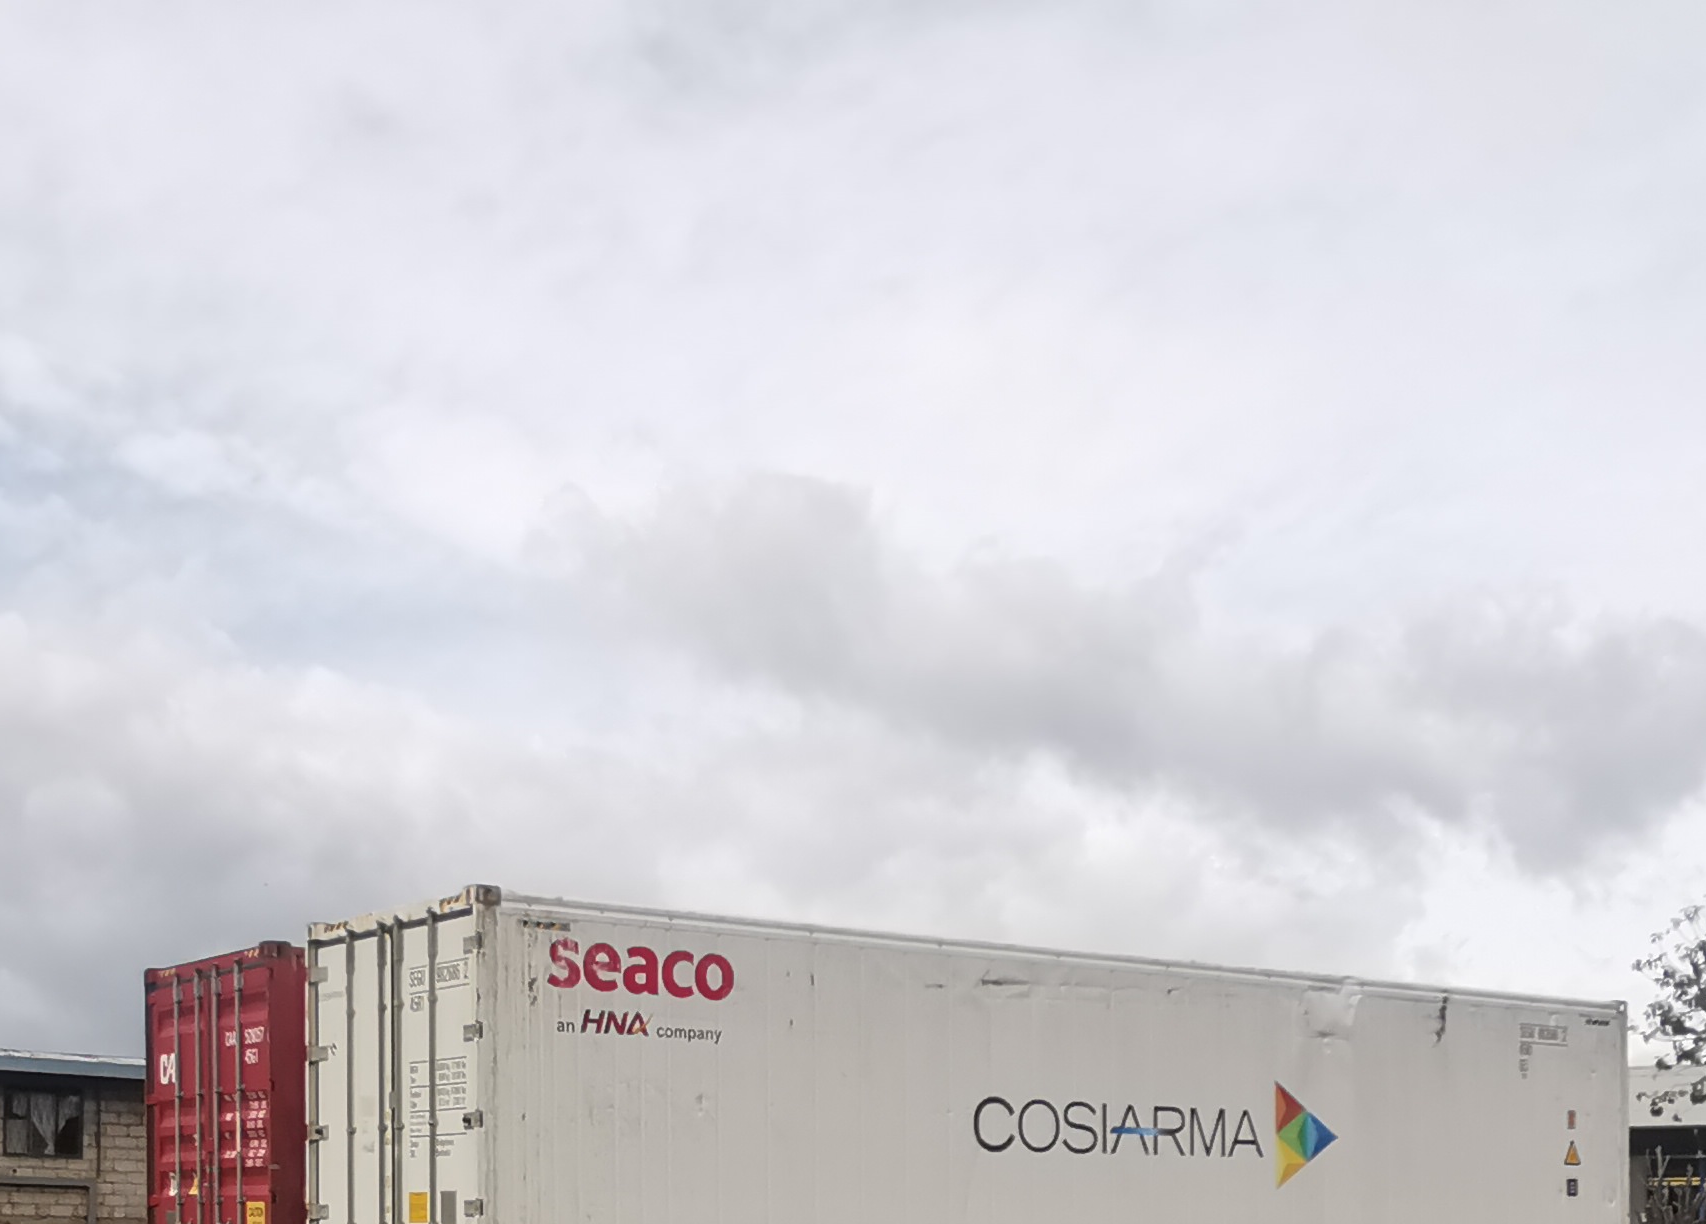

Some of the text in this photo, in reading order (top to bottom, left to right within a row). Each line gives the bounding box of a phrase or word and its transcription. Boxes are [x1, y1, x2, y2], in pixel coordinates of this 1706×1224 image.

[547, 936, 734, 1001] seaco
[556, 1009, 723, 1045] an HNA company
[973, 1096, 1264, 1158] COSIARMA
